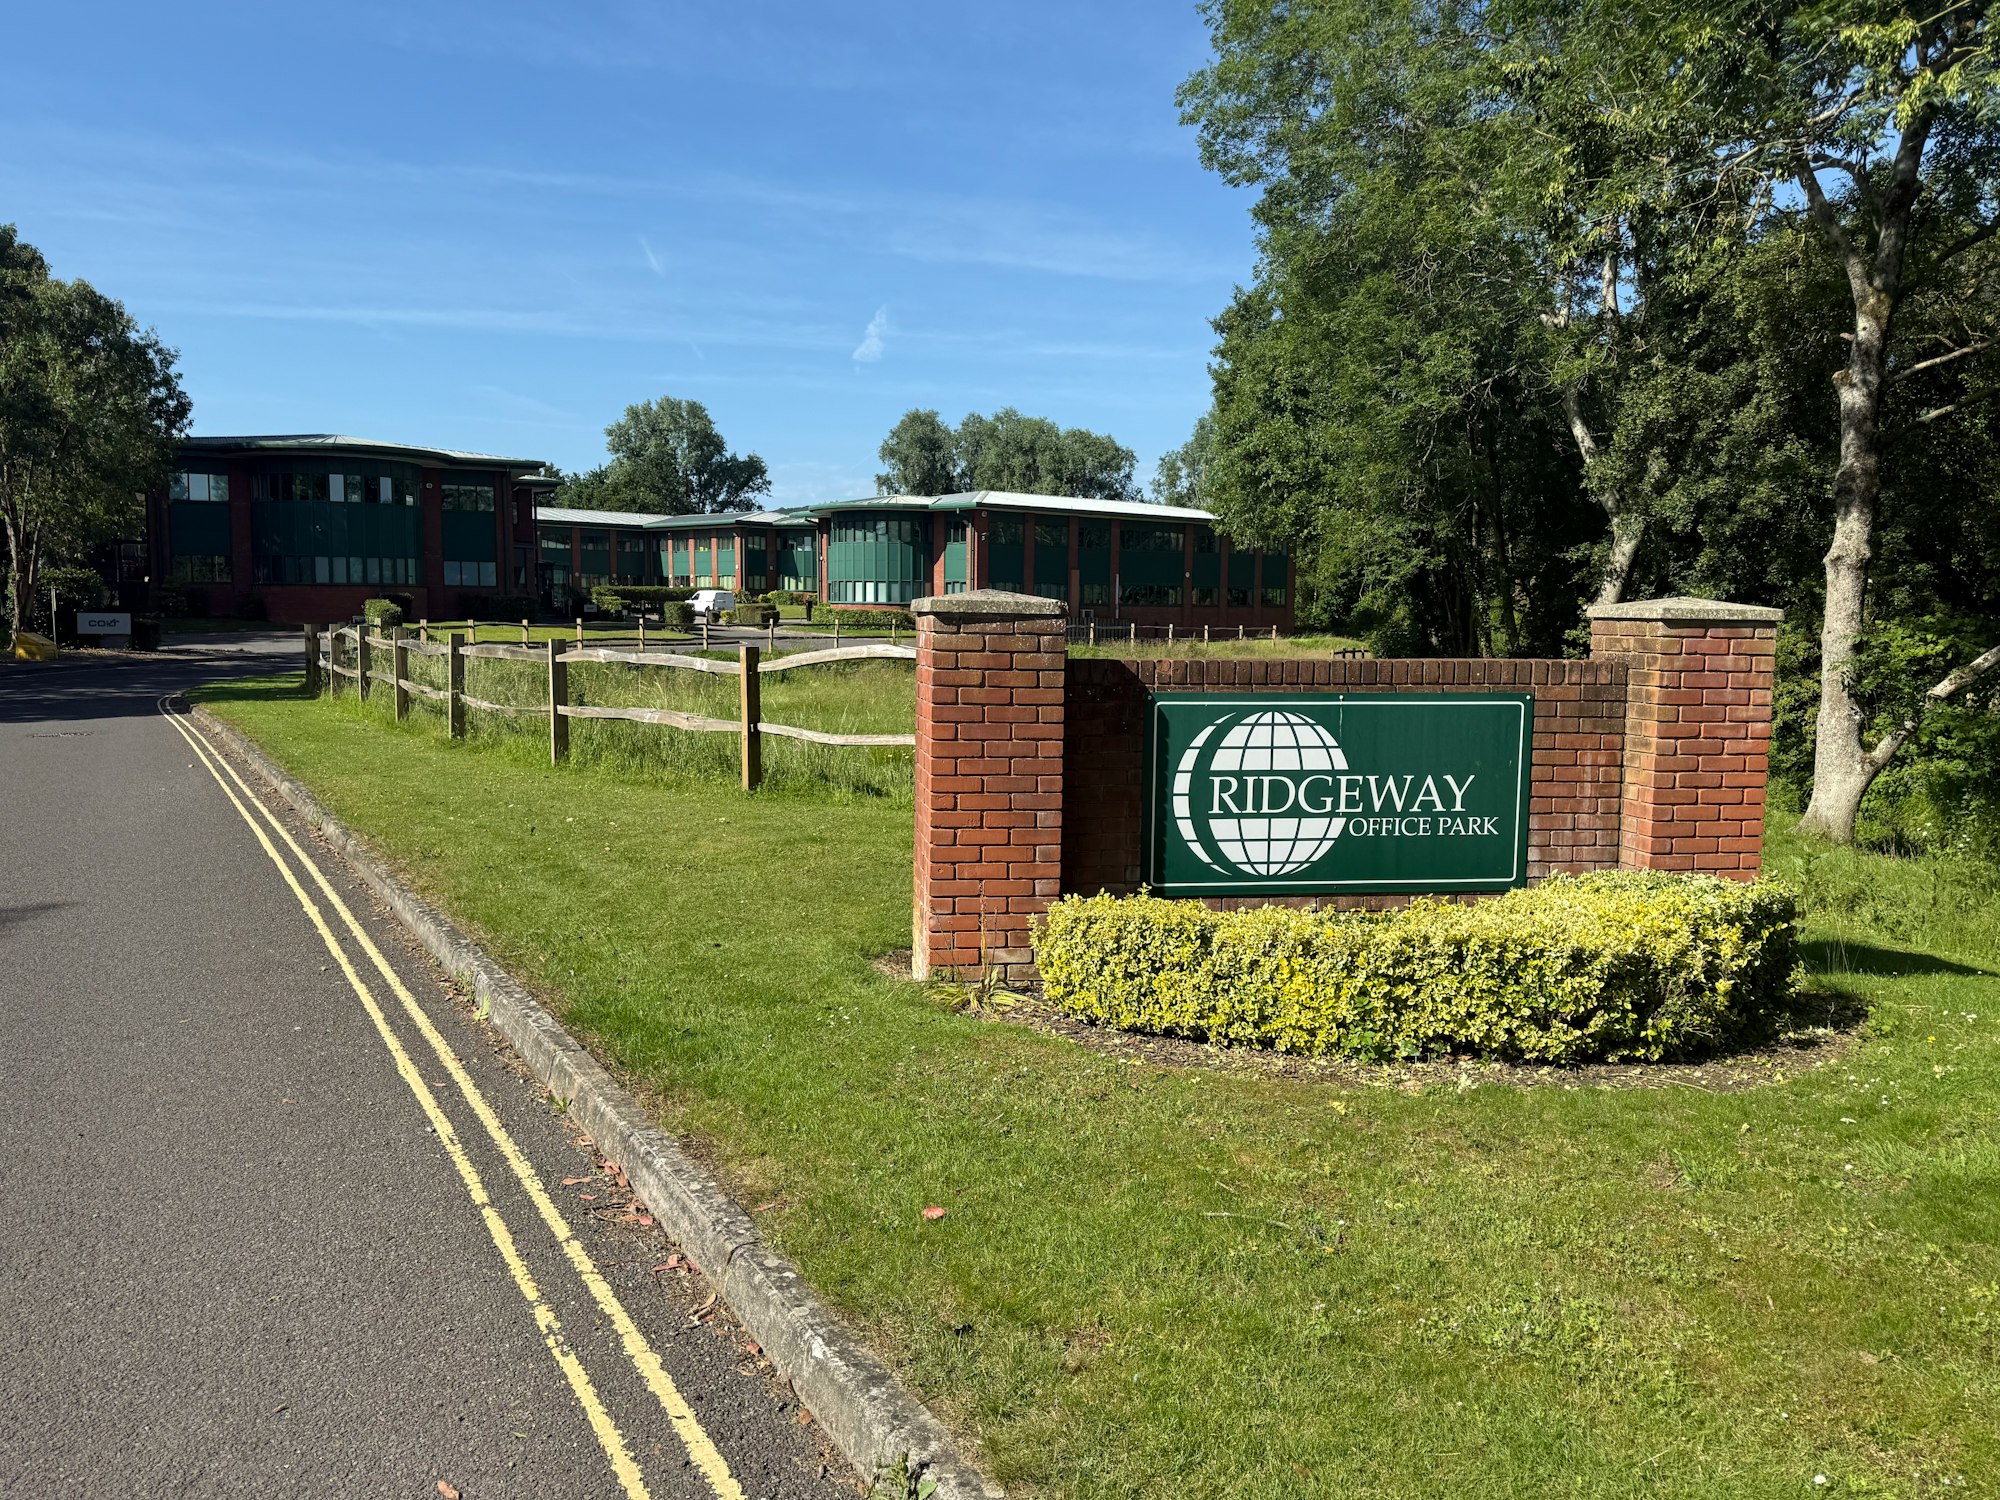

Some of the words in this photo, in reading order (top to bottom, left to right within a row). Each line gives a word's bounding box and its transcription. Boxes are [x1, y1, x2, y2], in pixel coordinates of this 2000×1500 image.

[1207, 774, 1476, 814] RIDGEWAY
[1348, 817, 1432, 837] OFFICE
[1437, 816, 1499, 836] PARK
